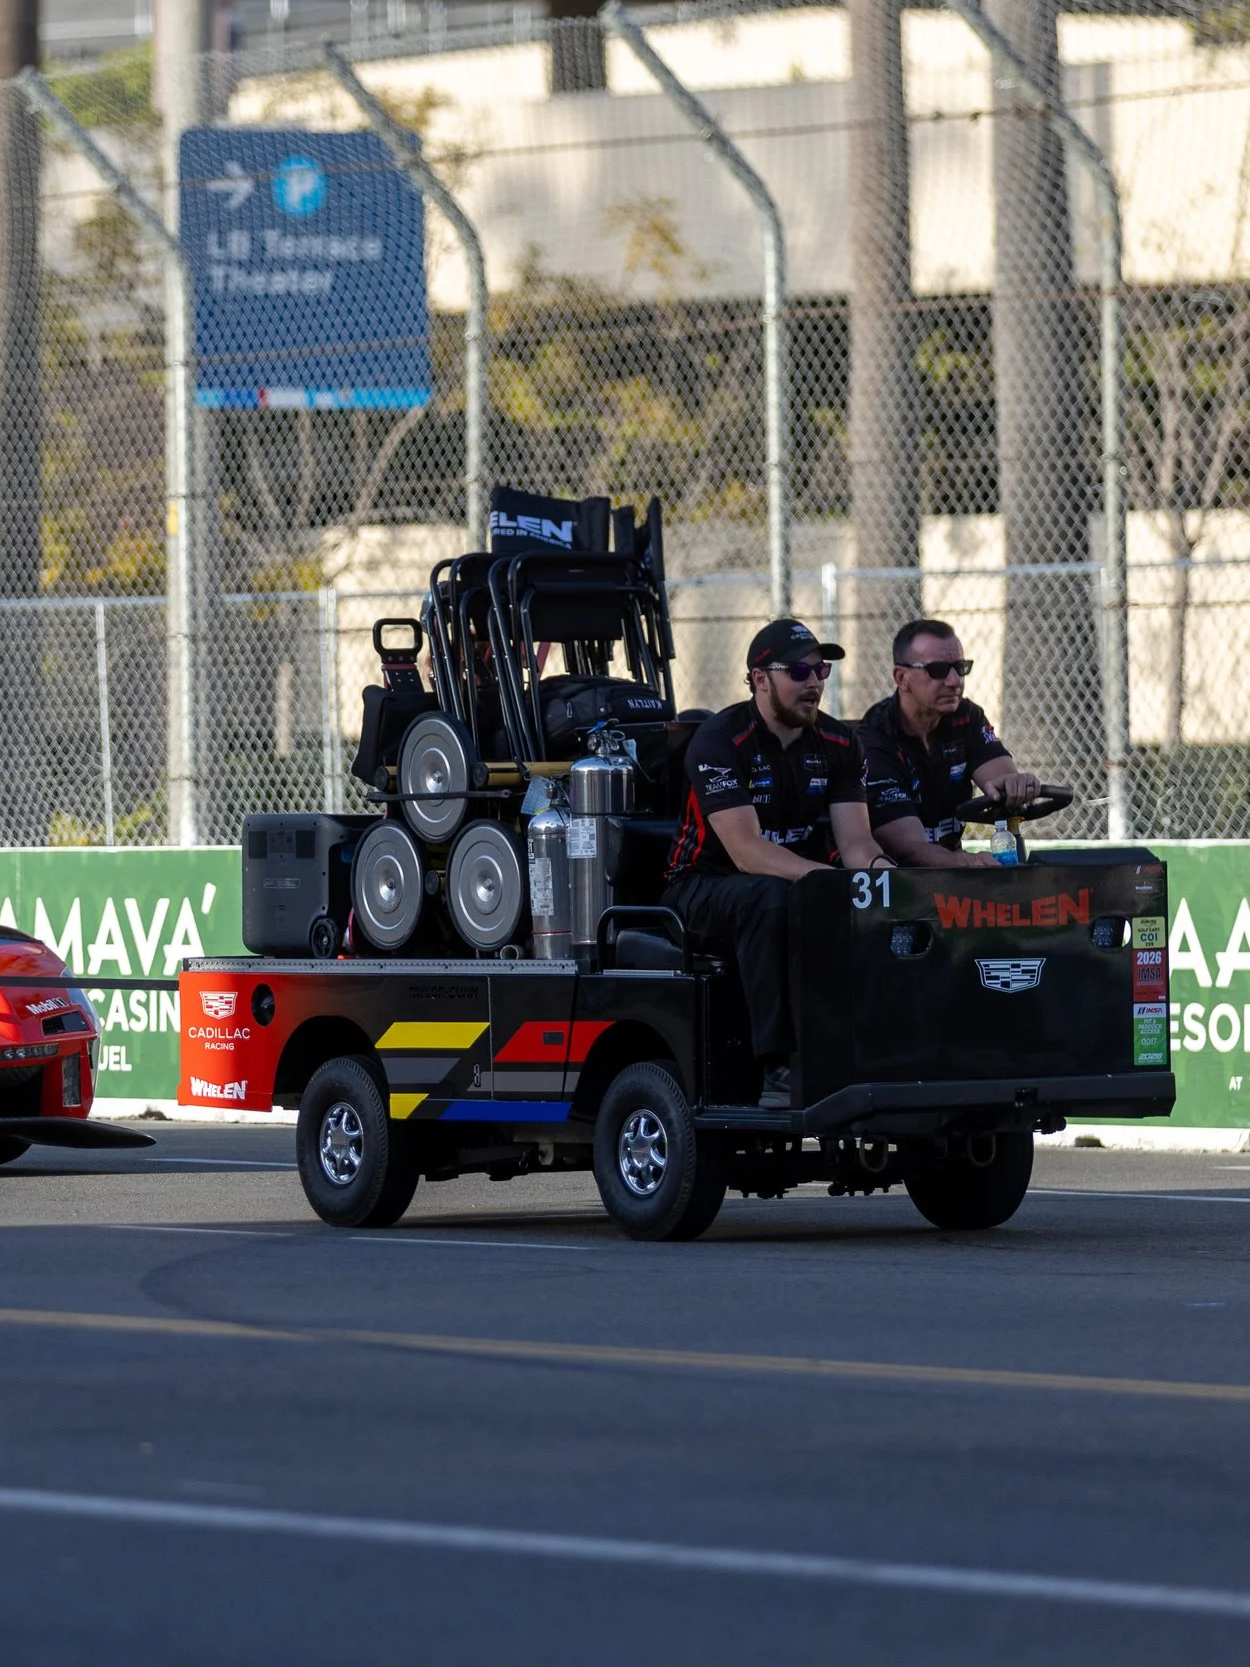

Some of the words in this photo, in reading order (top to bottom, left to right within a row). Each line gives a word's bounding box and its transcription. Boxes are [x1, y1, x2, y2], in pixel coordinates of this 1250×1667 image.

[263, 228, 383, 261] Terrace
[210, 264, 335, 295] Theater
[852, 870, 890, 909] 31
[932, 888, 1090, 928] WHELEN
[1137, 951, 1162, 965] 2026
[1138, 967, 1161, 980] IMSA
[25, 998, 56, 1015] Mobil
[188, 1027, 250, 1039] CADILLAC
[204, 1042, 235, 1051] RACING
[190, 1075, 247, 1100] WHELEN
[1229, 1076, 1243, 1090] AT
